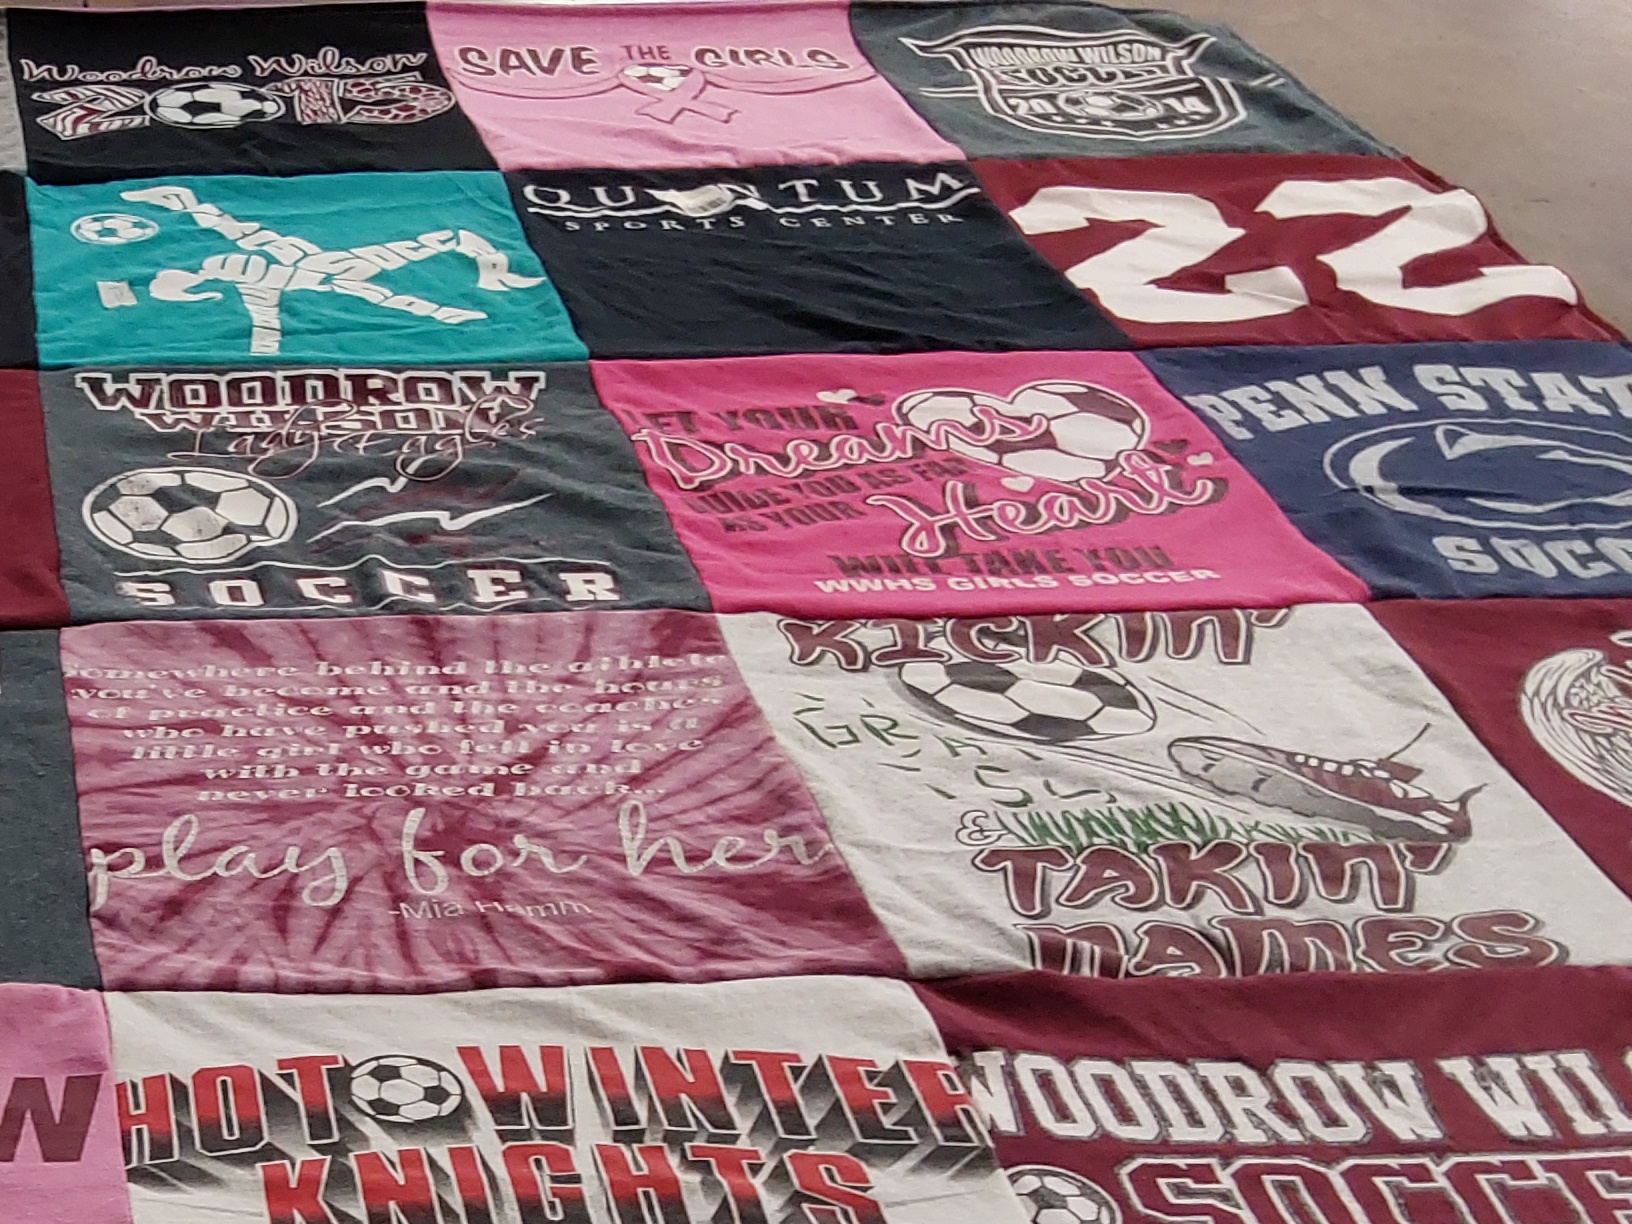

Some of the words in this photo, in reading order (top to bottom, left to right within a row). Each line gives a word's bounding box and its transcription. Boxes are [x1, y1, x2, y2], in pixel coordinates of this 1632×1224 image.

[20, 56, 243, 82] Woodrow
[248, 46, 428, 77] Wilson
[457, 46, 601, 77] SAVE
[620, 44, 672, 62] THE
[692, 46, 852, 71] GIRLS
[1077, 42, 1166, 65] WILSON
[564, 216, 747, 232] SPORTS
[779, 212, 966, 230] CENTER
[1008, 177, 1578, 323] 22
[75, 370, 546, 411] WOODROW
[1183, 364, 1419, 440] PENN
[631, 403, 1052, 490] Dreams
[867, 450, 1228, 558] Heart
[964, 549, 1071, 575] TAKE
[1077, 544, 1176, 570] YOU
[116, 568, 621, 607] SOCCER
[814, 573, 938, 596] WWHS
[948, 573, 1060, 593] GIRLS
[1067, 567, 1224, 588] SOCCER
[317, 659, 468, 678] behind
[484, 658, 551, 675] the
[222, 683, 389, 699] become
[405, 681, 490, 697] and
[506, 680, 572, 696] the
[147, 702, 335, 722] practice
[348, 701, 436, 717] and
[453, 700, 520, 716] the
[123, 724, 206, 741] who
[219, 723, 329, 738] have
[256, 742, 342, 760] girl
[359, 740, 444, 757] who
[611, 737, 705, 754] love
[200, 763, 302, 781] with
[315, 762, 388, 778] the
[404, 760, 536, 779] game
[197, 785, 329, 802] never
[343, 781, 497, 800] looked
[88, 812, 348, 912] play
[400, 805, 587, 898] for
[620, 798, 838, 878] her
[114, 1053, 353, 1168] HOT
[456, 1044, 990, 1152] WINTER
[956, 1049, 1448, 1145] WOODROW
